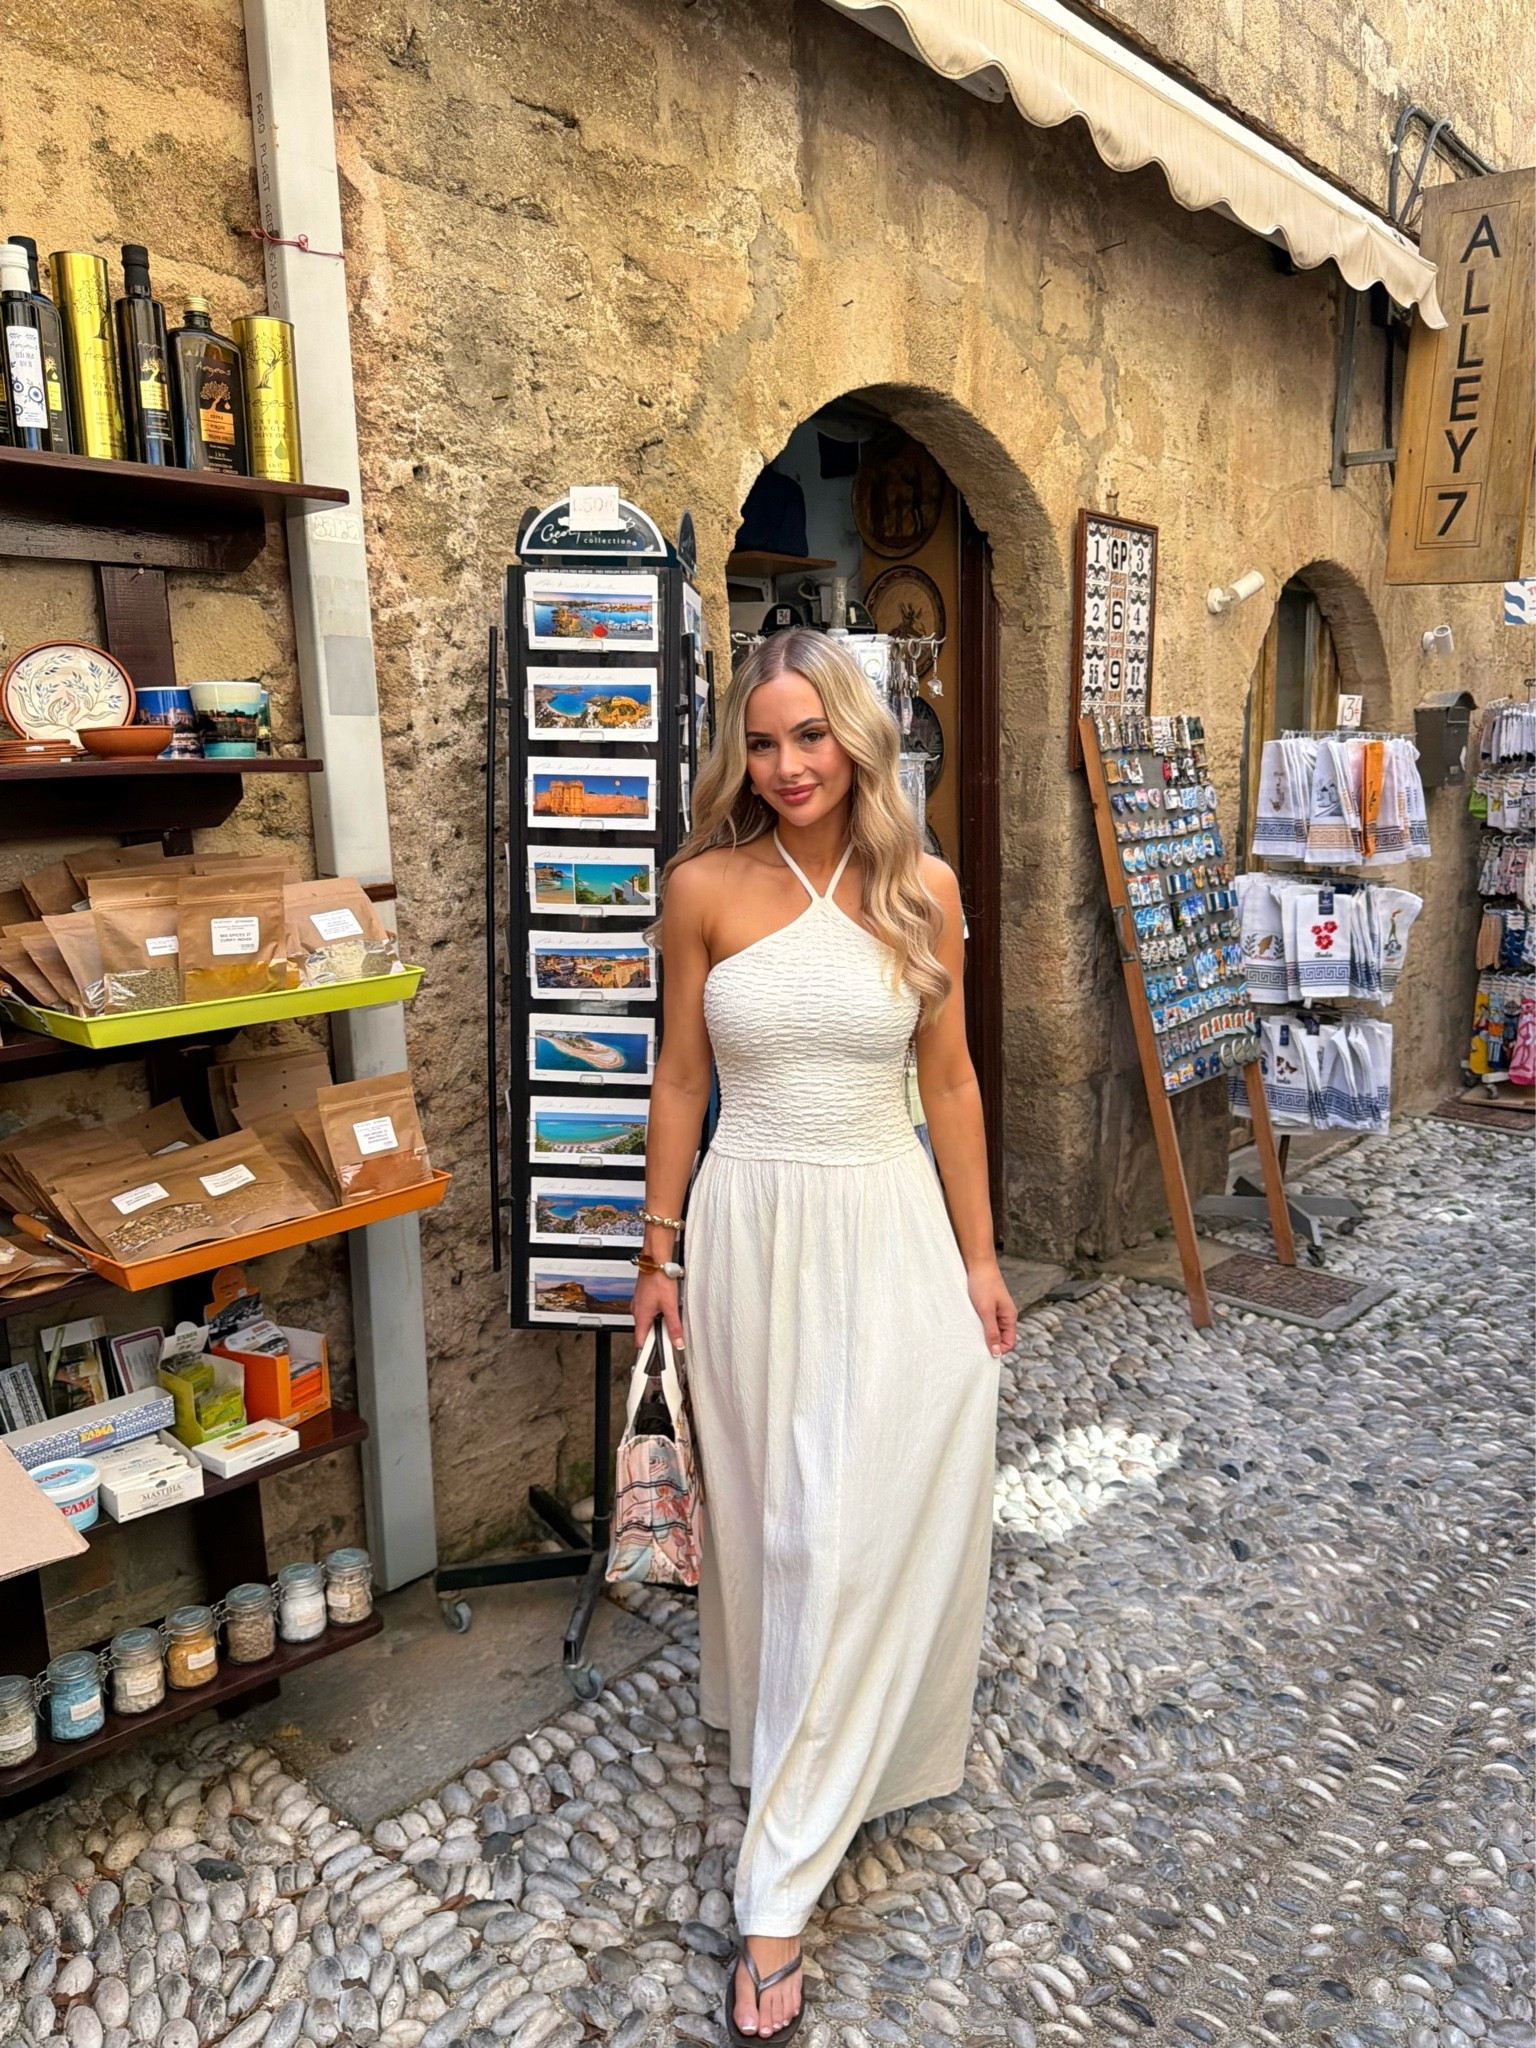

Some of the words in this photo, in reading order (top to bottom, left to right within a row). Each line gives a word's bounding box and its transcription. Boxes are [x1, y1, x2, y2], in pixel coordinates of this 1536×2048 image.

[260, 142, 271, 194] PLAST
[1443, 213, 1501, 475] ALLEY
[195, 361, 232, 378] Aegeas
[1436, 490, 1468, 537] 7
[583, 536, 632, 545] collection
[1093, 539, 1101, 564] 1
[1110, 539, 1129, 571] GP
[1136, 548, 1145, 573] 3
[1092, 602, 1101, 622] 2
[1111, 600, 1124, 630] 6
[1133, 607, 1142, 626] 4
[1088, 663, 1099, 685] 55
[1109, 660, 1121, 690] 9
[142, 1484, 182, 1502] MASTIHA
